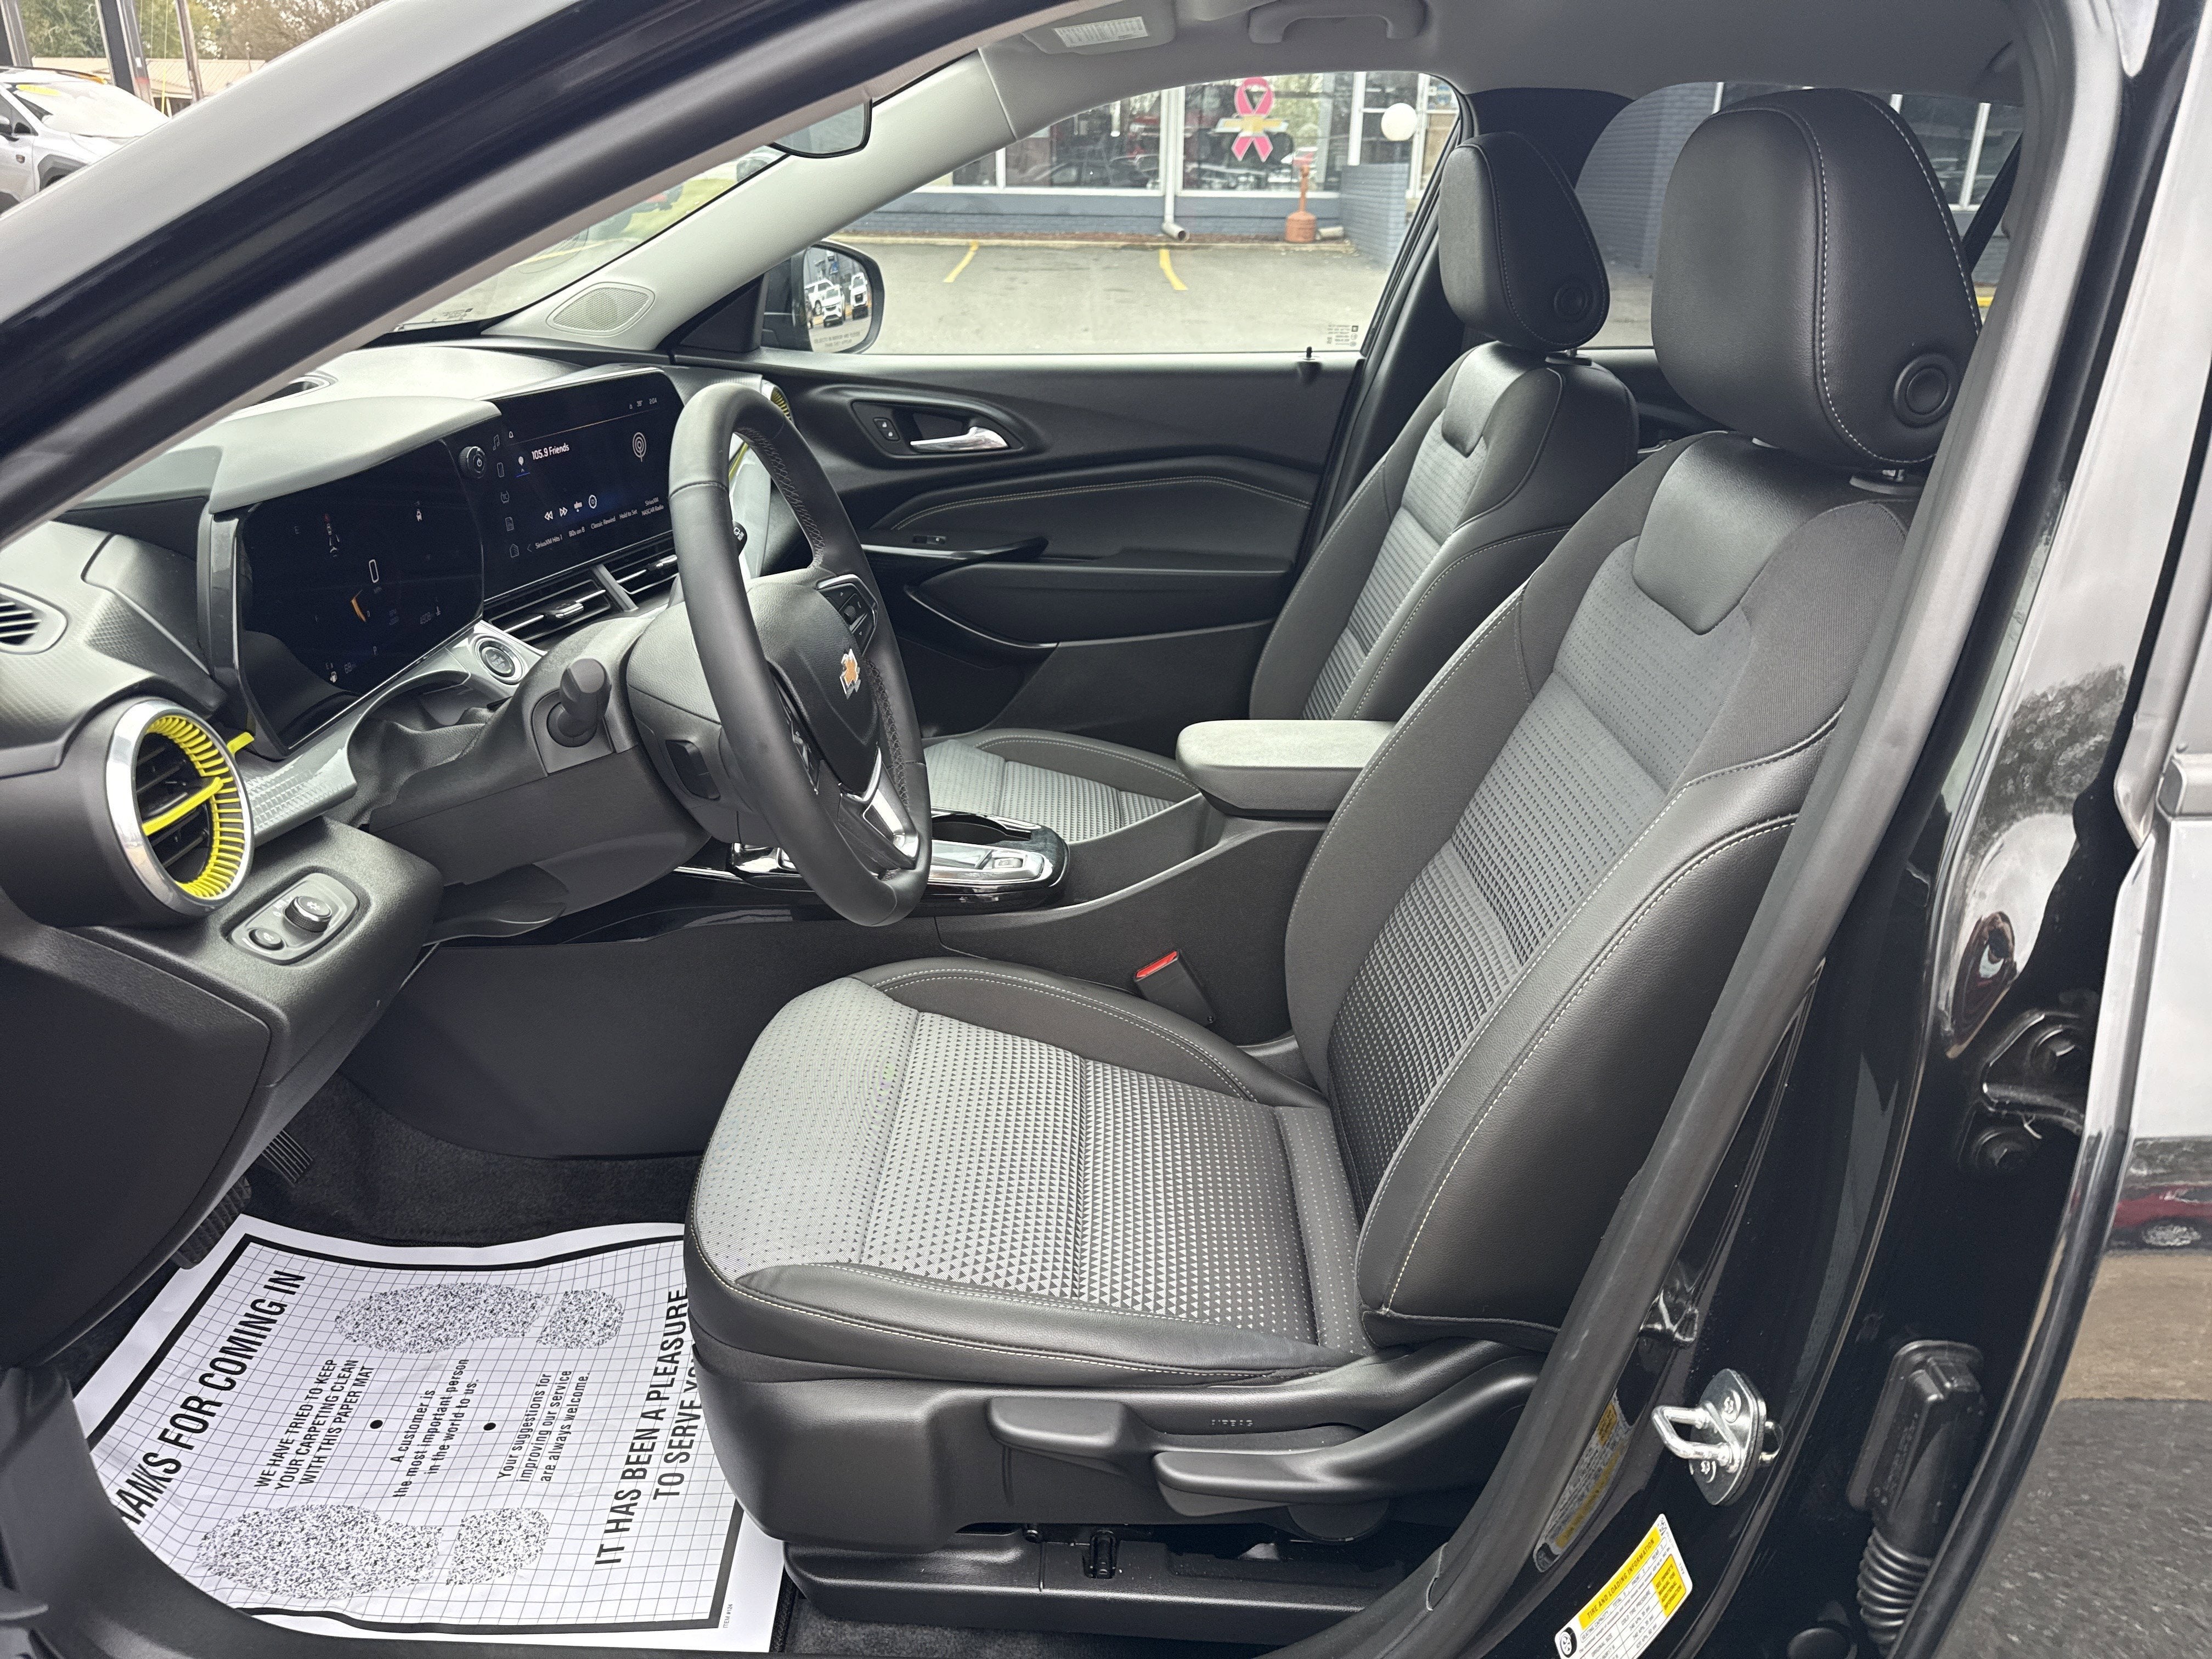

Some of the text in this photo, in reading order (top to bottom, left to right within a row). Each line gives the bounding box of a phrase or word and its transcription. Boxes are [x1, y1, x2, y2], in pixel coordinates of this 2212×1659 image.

[532, 443, 569, 460] 105.9 Friends
[368, 558, 379, 583] 0
[535, 538, 552, 549] SiriusXM
[157, 1396, 223, 1451] FOR
[199, 1299, 288, 1391] COMING
[263, 1270, 306, 1295] IN
[254, 1359, 337, 1487] WE HAVE TRIED TO KEEP
[274, 1359, 359, 1490] YOUR CARPETING CLEAN
[299, 1365, 374, 1485] WITH THIS PAPER MAT
[392, 1359, 469, 1498] the most important person
[398, 1402, 429, 1452] customer
[420, 1390, 436, 1400] is
[424, 1379, 479, 1475] in the world to us.
[496, 1374, 552, 1479] Your suggestions for
[516, 1370, 572, 1482] improving our service
[540, 1372, 590, 1482] are always welcome.
[595, 1288, 688, 1565] IT HAS BEEN A PLEASURE
[663, 1400, 702, 1463] SERVE
[653, 1472, 685, 1500] TO
[1587, 1538, 1655, 1619] TIRE AND LOADING INFORMATION
